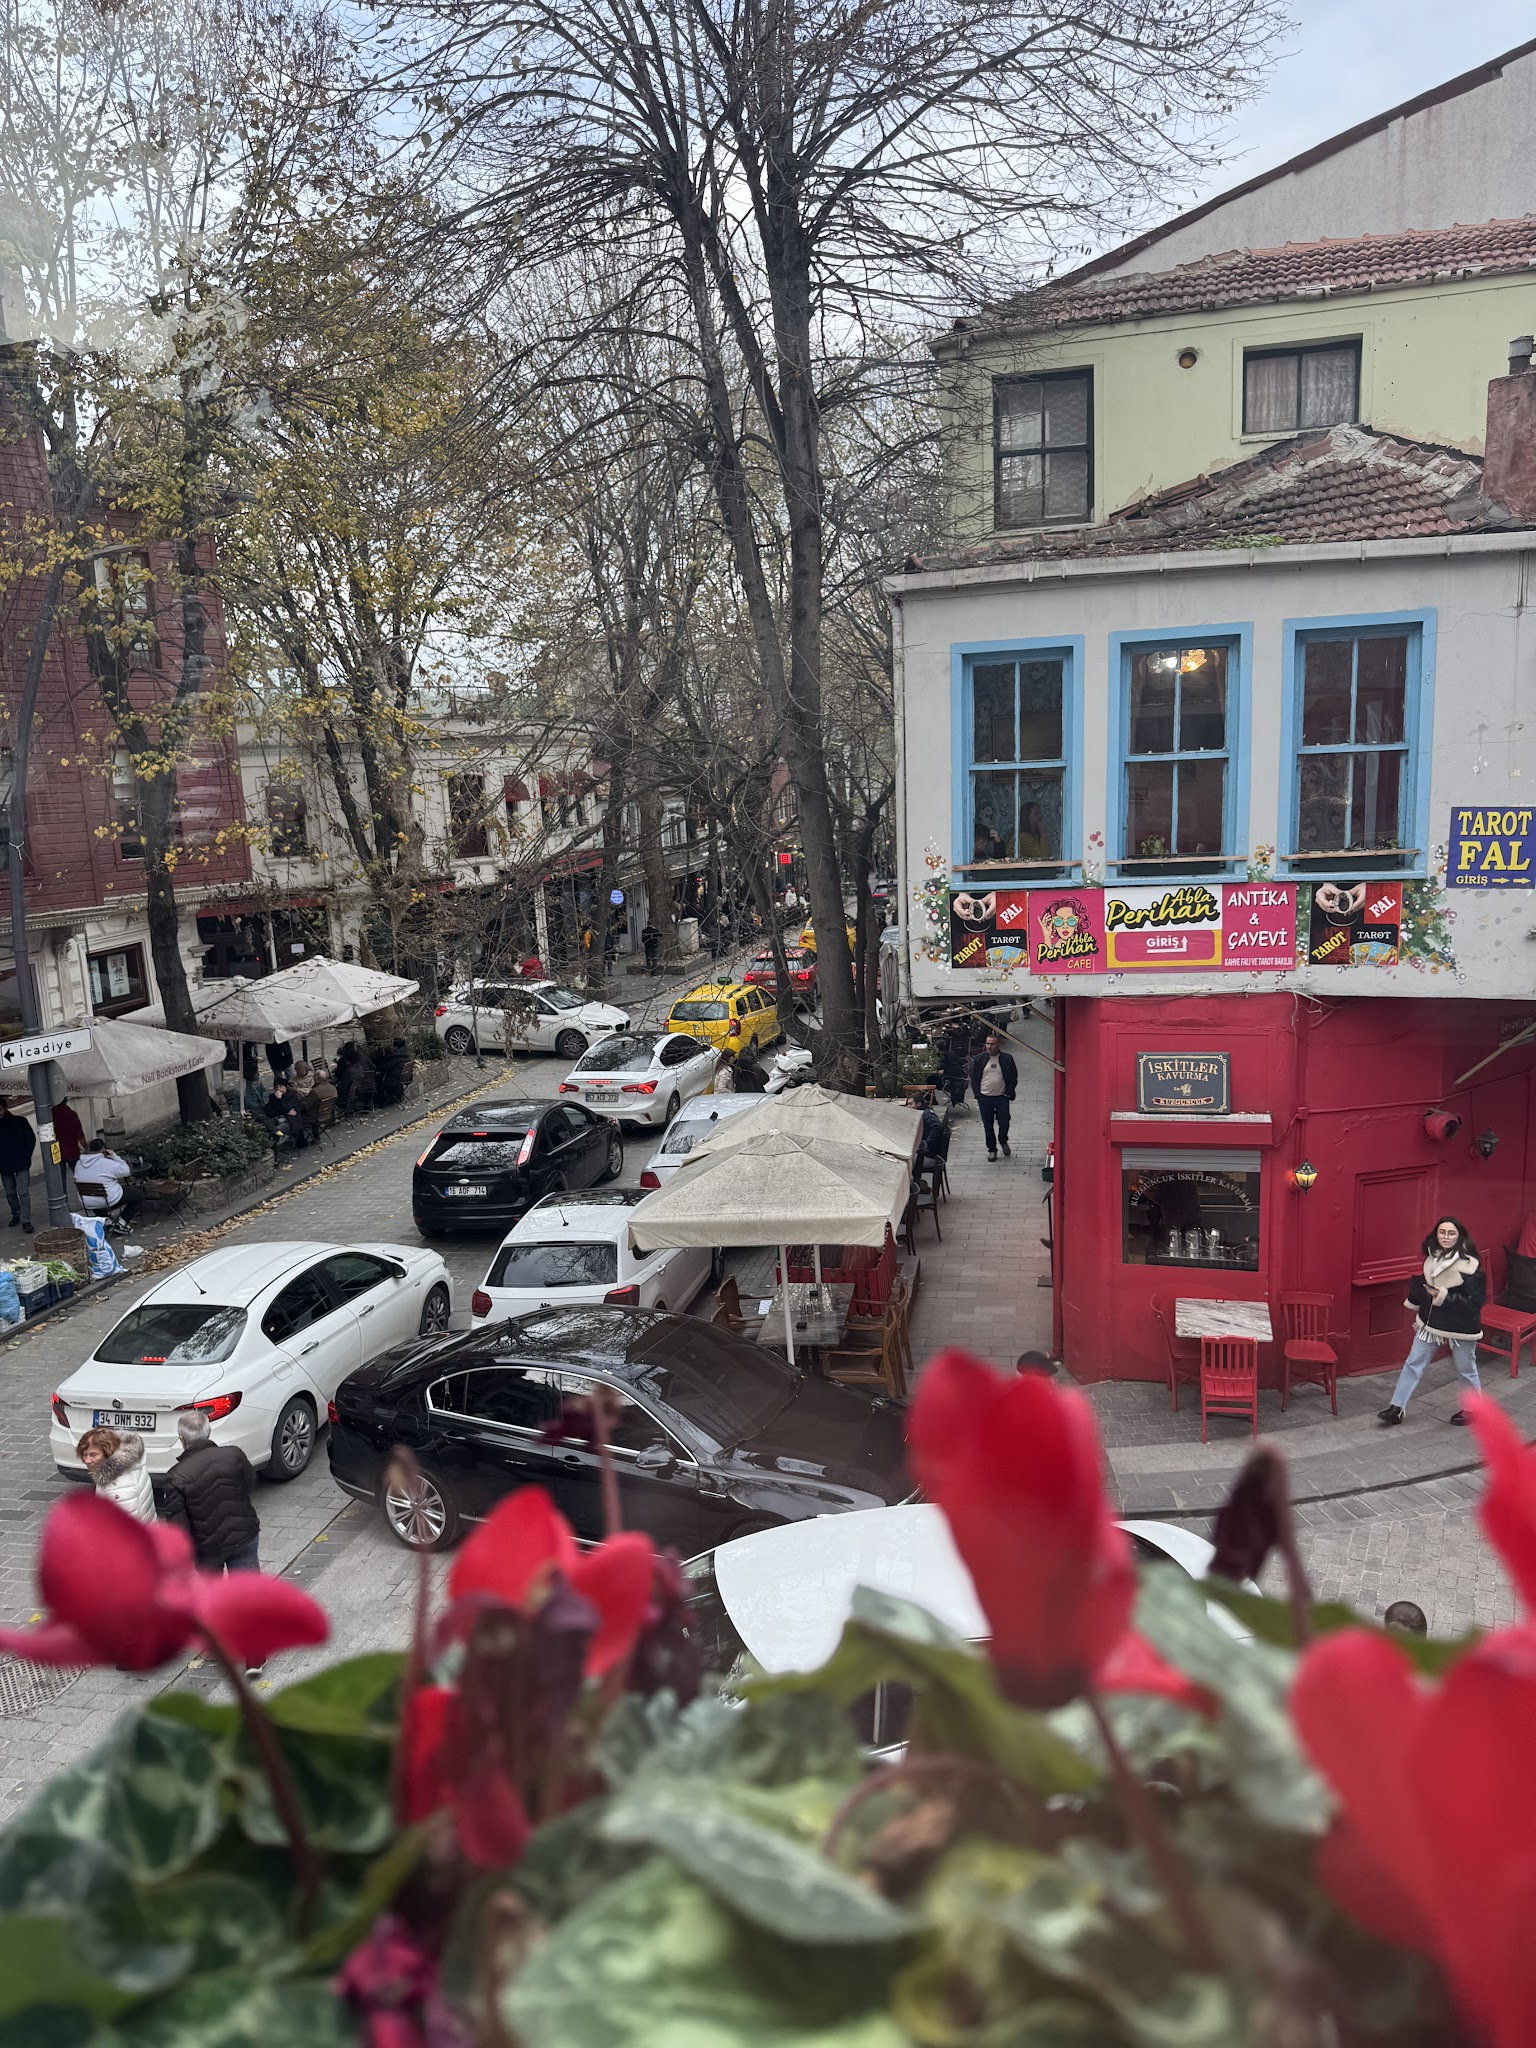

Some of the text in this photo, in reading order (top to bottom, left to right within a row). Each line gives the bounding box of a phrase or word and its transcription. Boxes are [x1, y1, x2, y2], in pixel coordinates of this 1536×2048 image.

[1458, 811, 1533, 836] TAROT
[1457, 841, 1531, 871] FAL
[1456, 873, 1488, 886] GİRİŞ
[1170, 887, 1214, 907] Abla
[1227, 887, 1289, 907] ANTİKA
[1368, 895, 1397, 918] FAL
[1000, 903, 1024, 925] FAL
[1106, 893, 1218, 928] Perihan
[1249, 912, 1260, 926] &
[991, 936, 1021, 944] TAROT
[1072, 933, 1095, 945] Abla
[1146, 935, 1179, 949] GİRİŞ
[1228, 928, 1288, 950] ÇAYEVİ
[1357, 931, 1391, 940] TAROT
[953, 937, 983, 965] TAROT
[1037, 938, 1097, 962] Perihan
[1311, 931, 1347, 960] TAROT
[1067, 959, 1092, 969] CAFE
[1224, 958, 1240, 967] KAHVE
[1258, 957, 1274, 966] TAROT
[156, 1062, 187, 1080] Bookstore
[1148, 1059, 1218, 1075] İSKİTLER
[1157, 1071, 1209, 1082] KAVURMA
[1130, 1174, 1175, 1207] KUZGUNCUK
[1219, 1179, 1253, 1212] KAVURMA
[100, 1413, 152, 1427] 34 DNM 932
